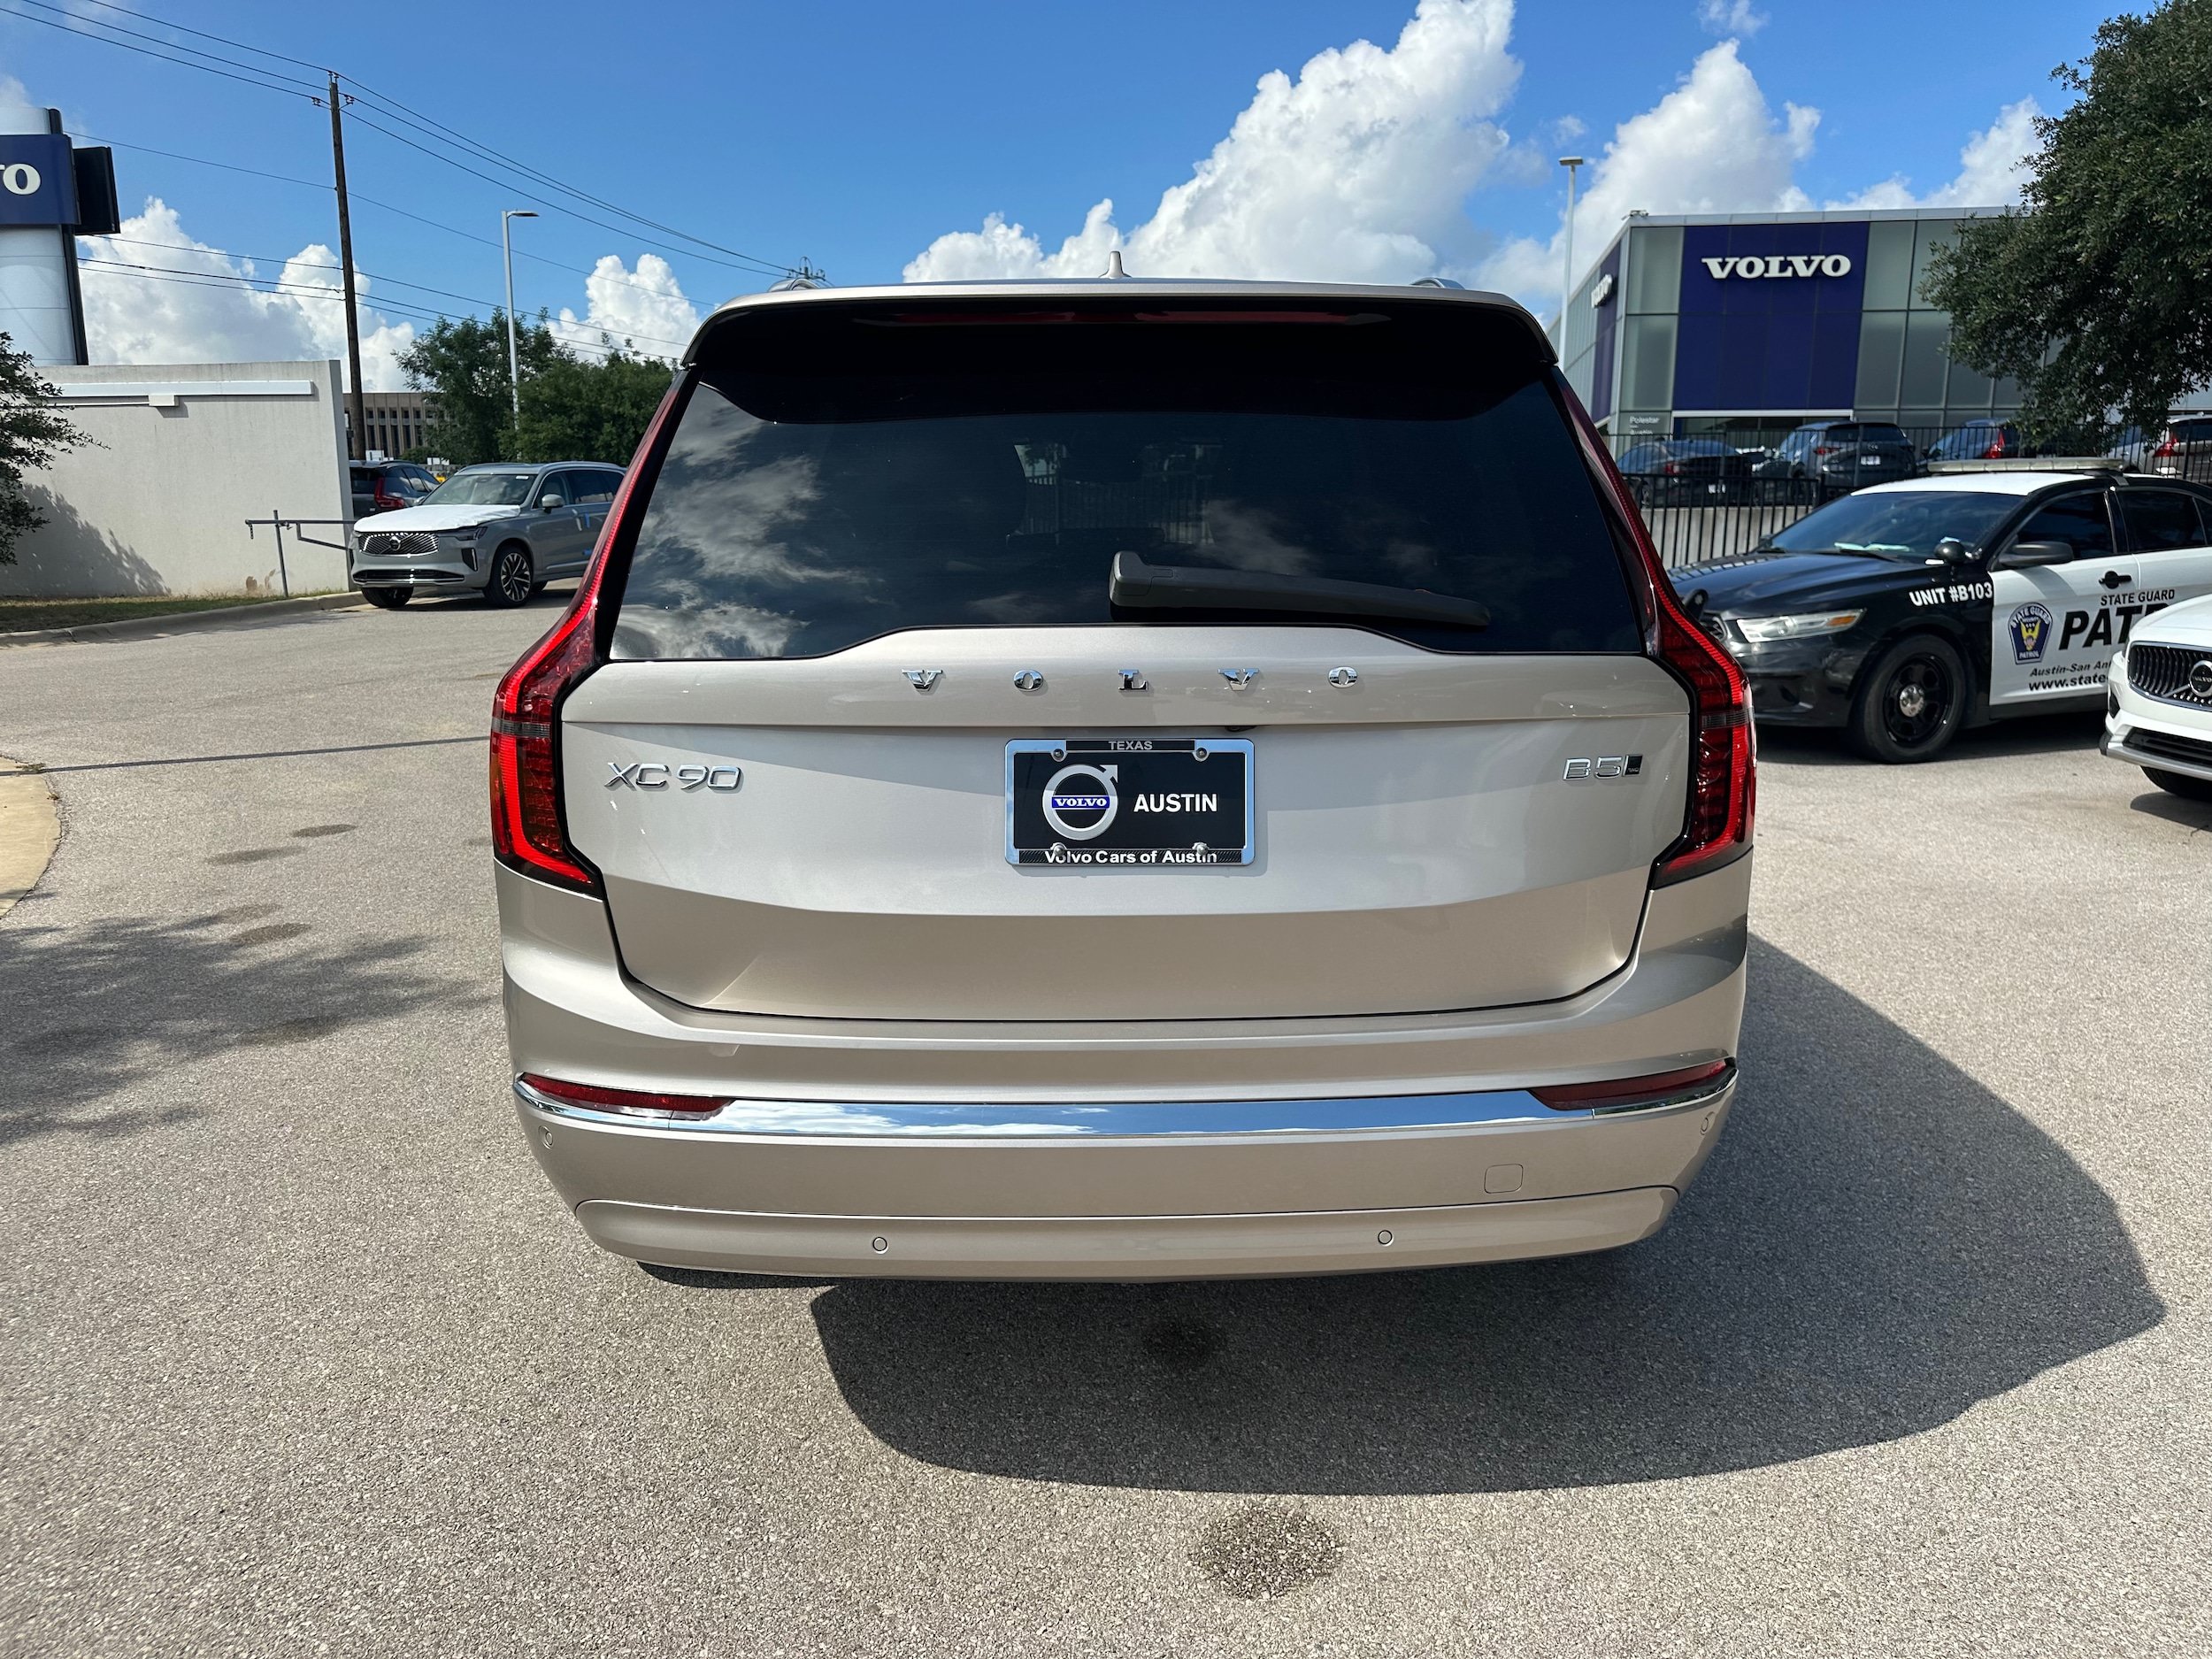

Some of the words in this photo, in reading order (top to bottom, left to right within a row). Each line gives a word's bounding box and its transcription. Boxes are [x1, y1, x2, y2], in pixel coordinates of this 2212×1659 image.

[0, 164, 41, 195] O
[1701, 255, 1851, 279] VOLVO
[1909, 587, 1946, 607] UNIT
[1948, 581, 1993, 603] #B103
[2101, 592, 2134, 606] STATE
[2138, 589, 2175, 603] GUARD
[2009, 607, 2030, 629] STATE
[2030, 663, 2091, 677] Austin-San
[2029, 673, 2108, 691] www.state
[1108, 741, 1153, 750] TEXAS
[1054, 797, 1107, 807] VOLVO
[1133, 794, 1217, 812] AUSTIN
[1045, 850, 1092, 863] Volvo
[1095, 850, 1136, 864] Cars
[1140, 850, 1157, 864] of
[1161, 850, 1217, 864] Austin
